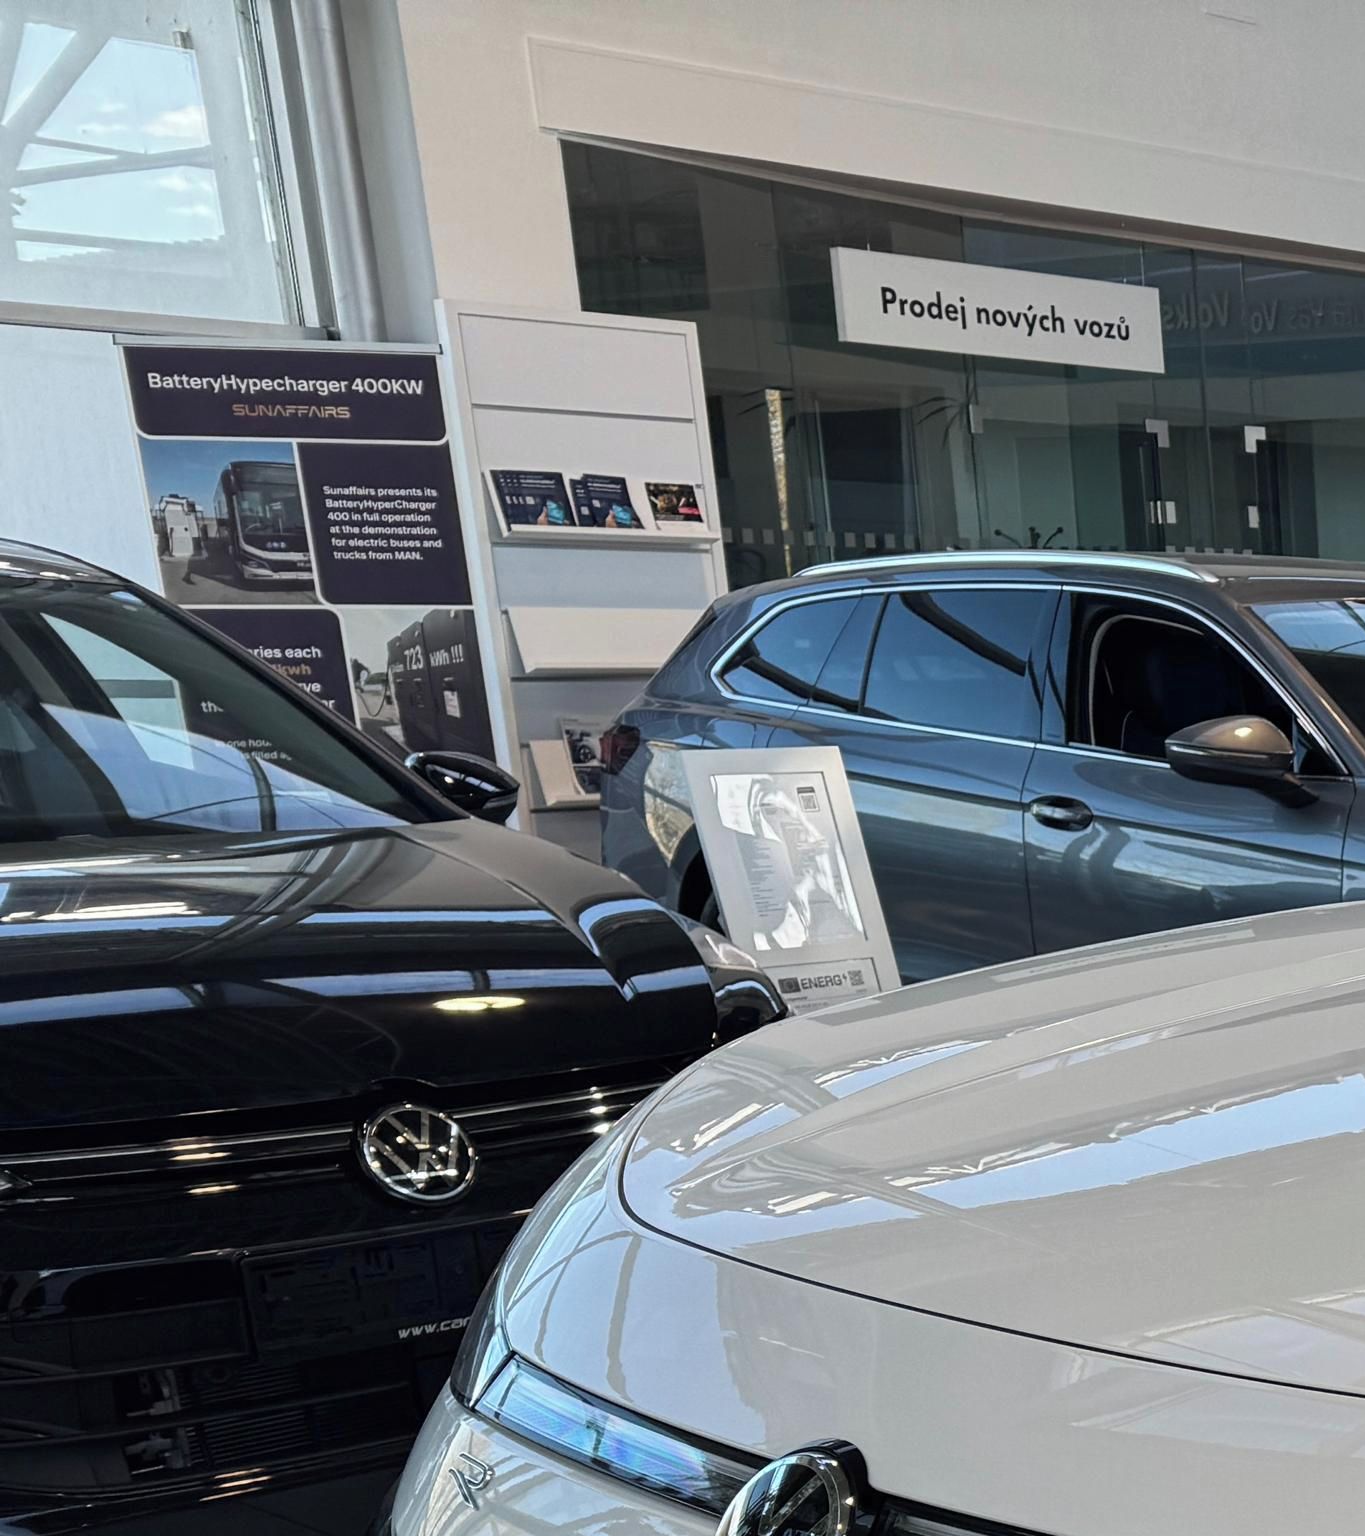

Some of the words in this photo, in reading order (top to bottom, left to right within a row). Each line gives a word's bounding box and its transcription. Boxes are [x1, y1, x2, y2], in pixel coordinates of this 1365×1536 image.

[880, 286, 967, 330] Prodej
[976, 304, 1065, 337] nových
[1073, 315, 1130, 341] vozů
[147, 372, 348, 396] BatteryHypecharger
[352, 377, 423, 396] 400KW
[232, 403, 351, 419] SUNAFFAIRS
[322, 485, 375, 496] Sunaffairs
[377, 487, 422, 498] presents
[424, 487, 437, 497] its
[325, 499, 437, 511] BatteryHyperCharger
[327, 511, 349, 521] 400
[351, 511, 361, 521] in
[362, 512, 379, 521] full
[381, 512, 431, 523] operation
[329, 525, 340, 534] at
[342, 525, 360, 534] the
[362, 525, 437, 535] demonstration
[331, 537, 346, 546] for
[348, 537, 388, 547] electric
[390, 538, 421, 548] buses
[422, 539, 442, 548] and
[333, 550, 367, 560] trucks
[368, 550, 393, 560] from
[395, 551, 424, 560] MAN.
[284, 645, 321, 658] each
[404, 645, 424, 671] 723
[801, 974, 843, 989] ENERG
